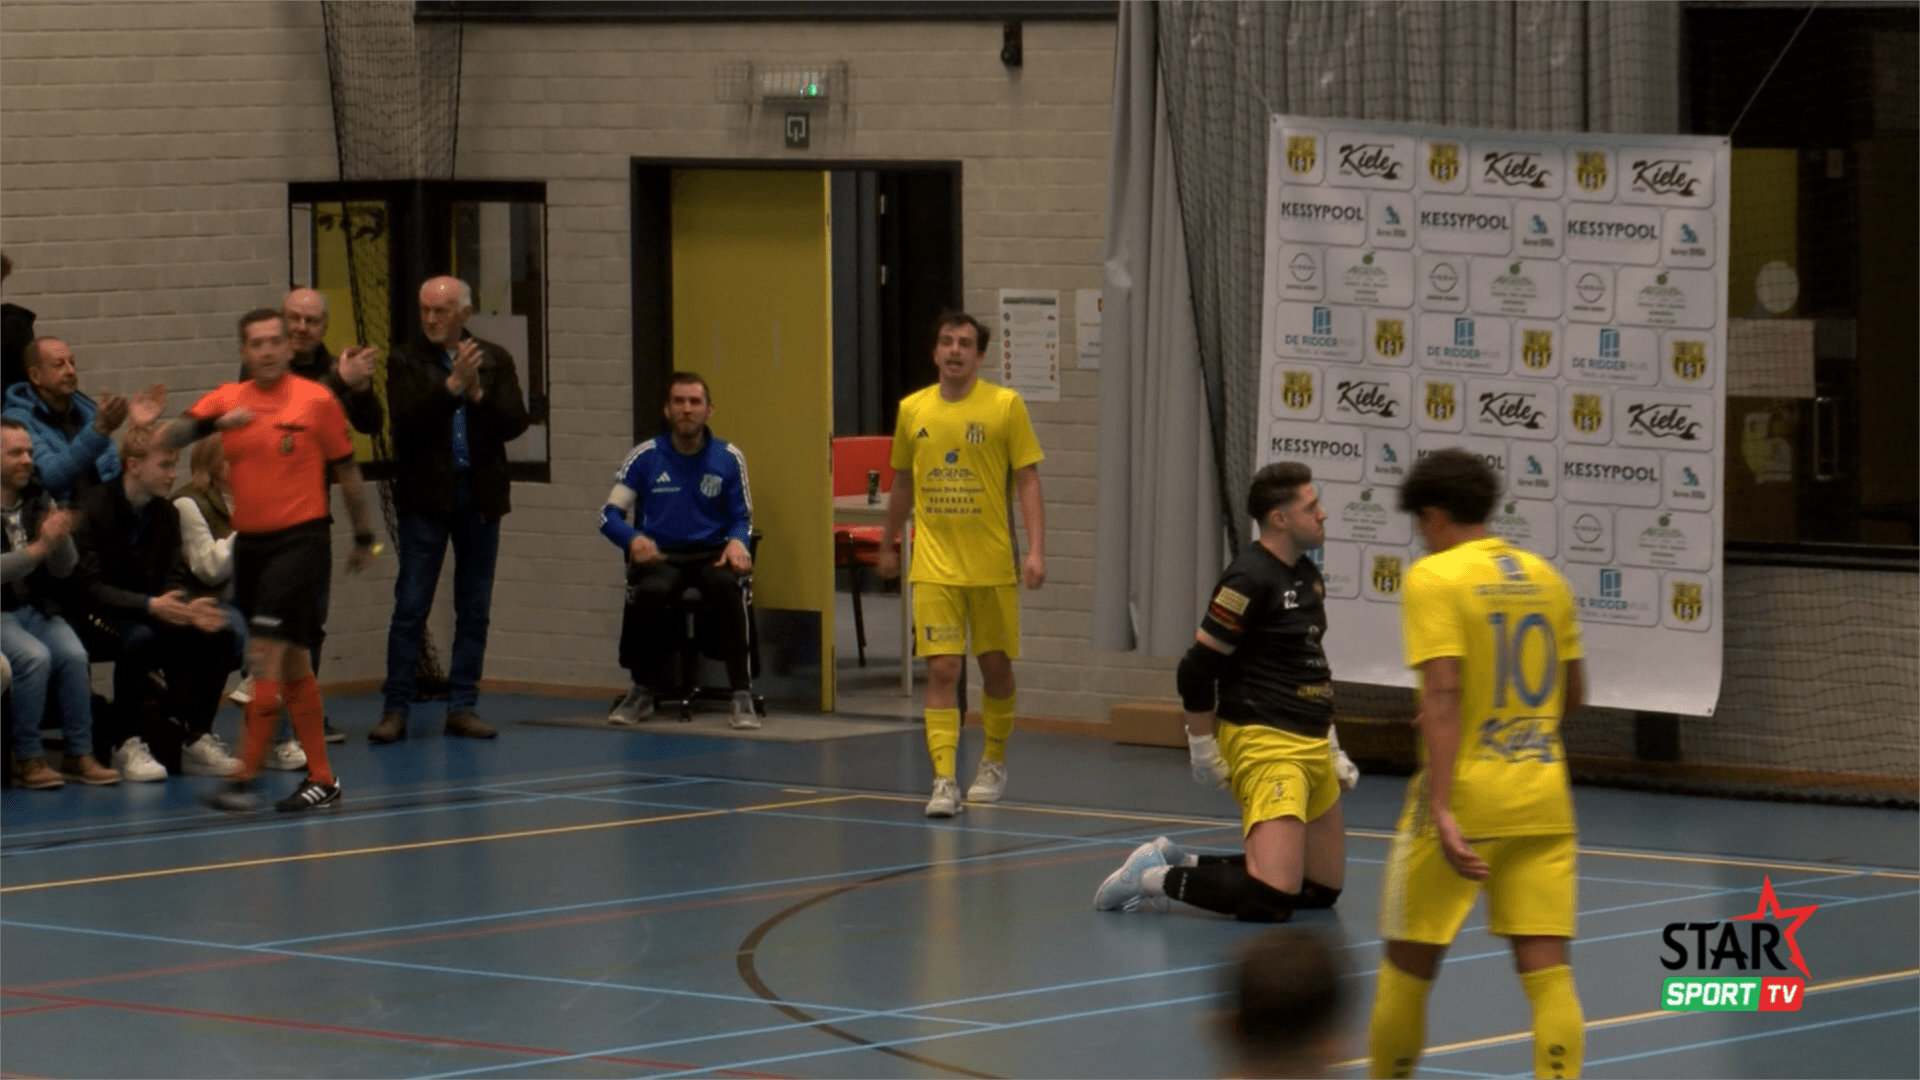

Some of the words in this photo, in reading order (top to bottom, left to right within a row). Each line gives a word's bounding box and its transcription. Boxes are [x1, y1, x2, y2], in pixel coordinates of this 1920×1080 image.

[1281, 202, 1364, 221] KESSYPOOL
[1420, 211, 1509, 230] KESSYPOOL
[1568, 220, 1658, 240] KESSYPOOL
[1286, 335, 1299, 344] DE
[1302, 336, 1338, 347] RIDDER
[1427, 346, 1440, 356] DE
[1444, 347, 1480, 358] RIDDER
[1573, 357, 1586, 368] DE
[1589, 358, 1626, 371] RIDDER
[1271, 437, 1362, 458] KESSYPOOL
[1564, 461, 1658, 482] KESSYPOOL
[1589, 599, 1628, 610] RIDDER
[1488, 612, 1557, 709] 10
